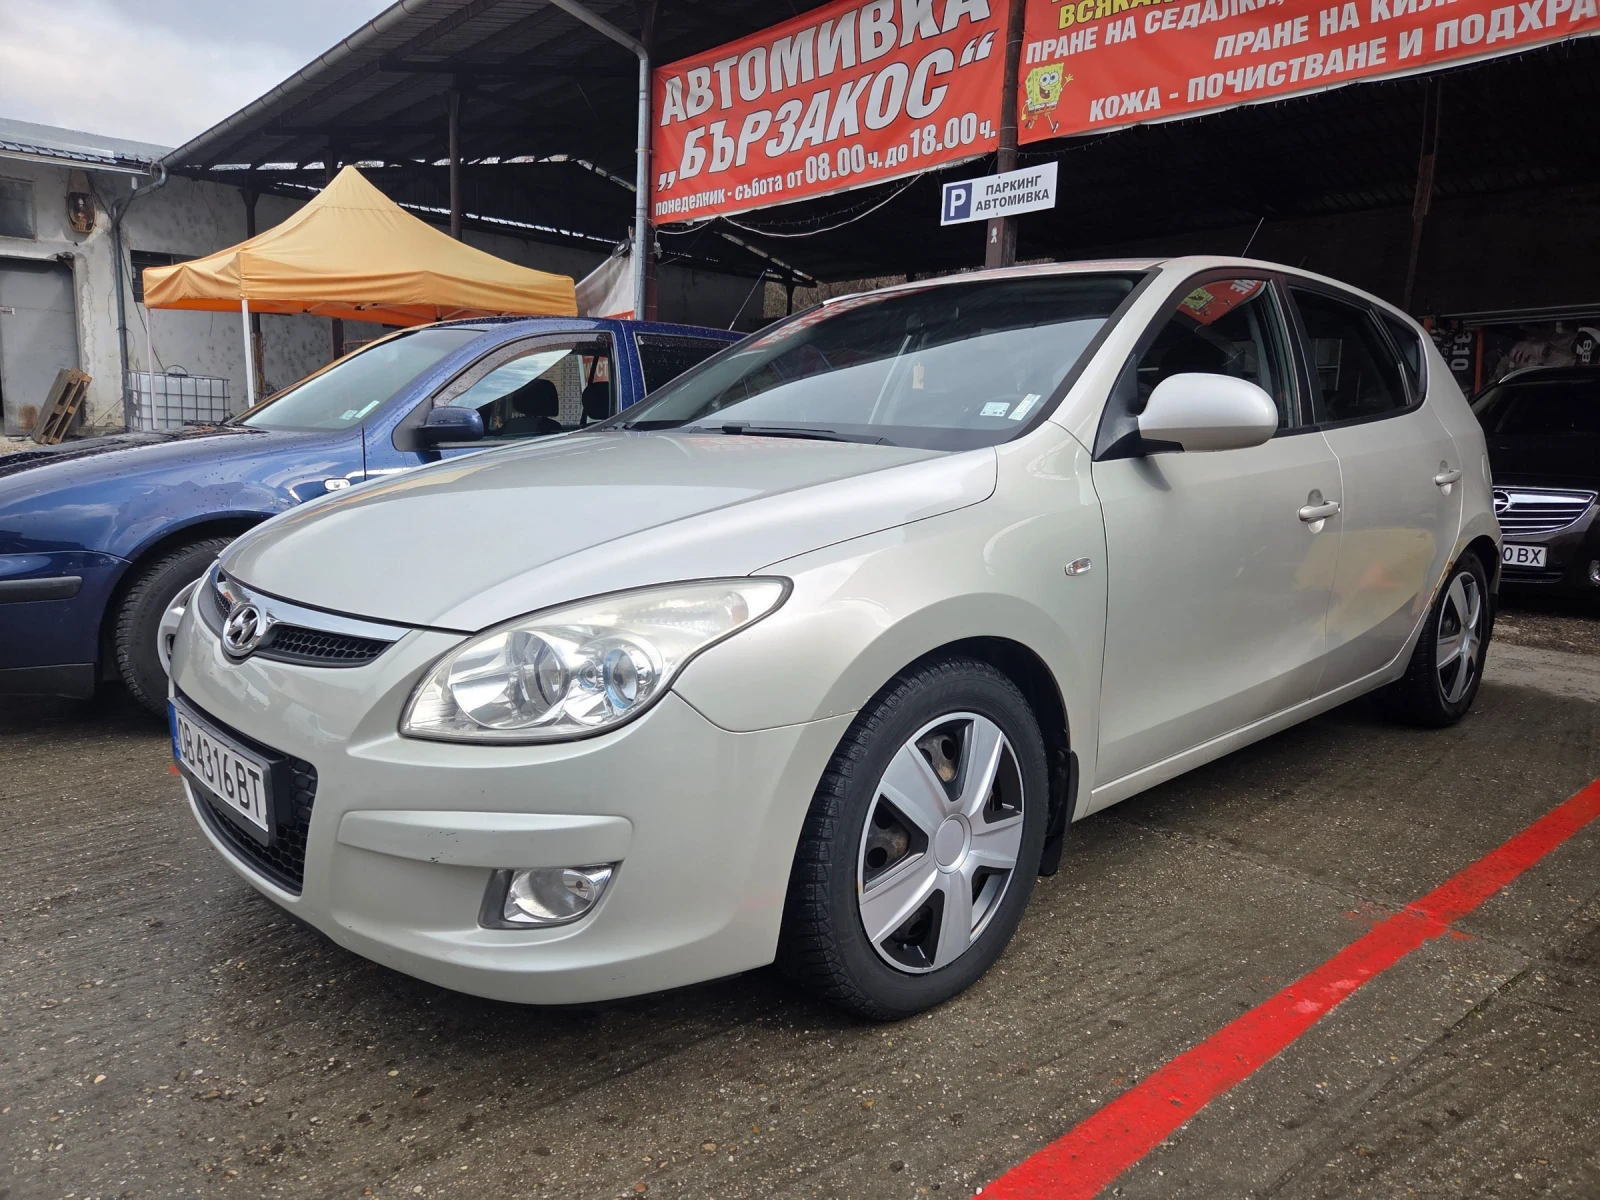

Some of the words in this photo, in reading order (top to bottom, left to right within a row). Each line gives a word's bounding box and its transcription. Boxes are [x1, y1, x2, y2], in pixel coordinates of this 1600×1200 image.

[1026, 26, 1099, 64] ПРАНЕ
[1105, 16, 1137, 45] НА
[1214, 15, 1309, 60] ПРАНЕ
[1319, 1, 1360, 37] НА
[661, 0, 990, 127] АВТОМИВКА
[1089, 86, 1161, 122] КОЖА
[1187, 36, 1387, 103] ПОЧИСТВАНЕ
[1398, 27, 1423, 60] И
[655, 188, 726, 217] понеделник
[735, 174, 783, 201] събота
[787, 169, 803, 189] от
[805, 143, 865, 184] 08.00
[885, 143, 908, 167] до
[909, 112, 978, 158] 18.00
[985, 175, 1042, 196] ПАРКИНГ
[975, 188, 1050, 212] АВТОМИВКА
